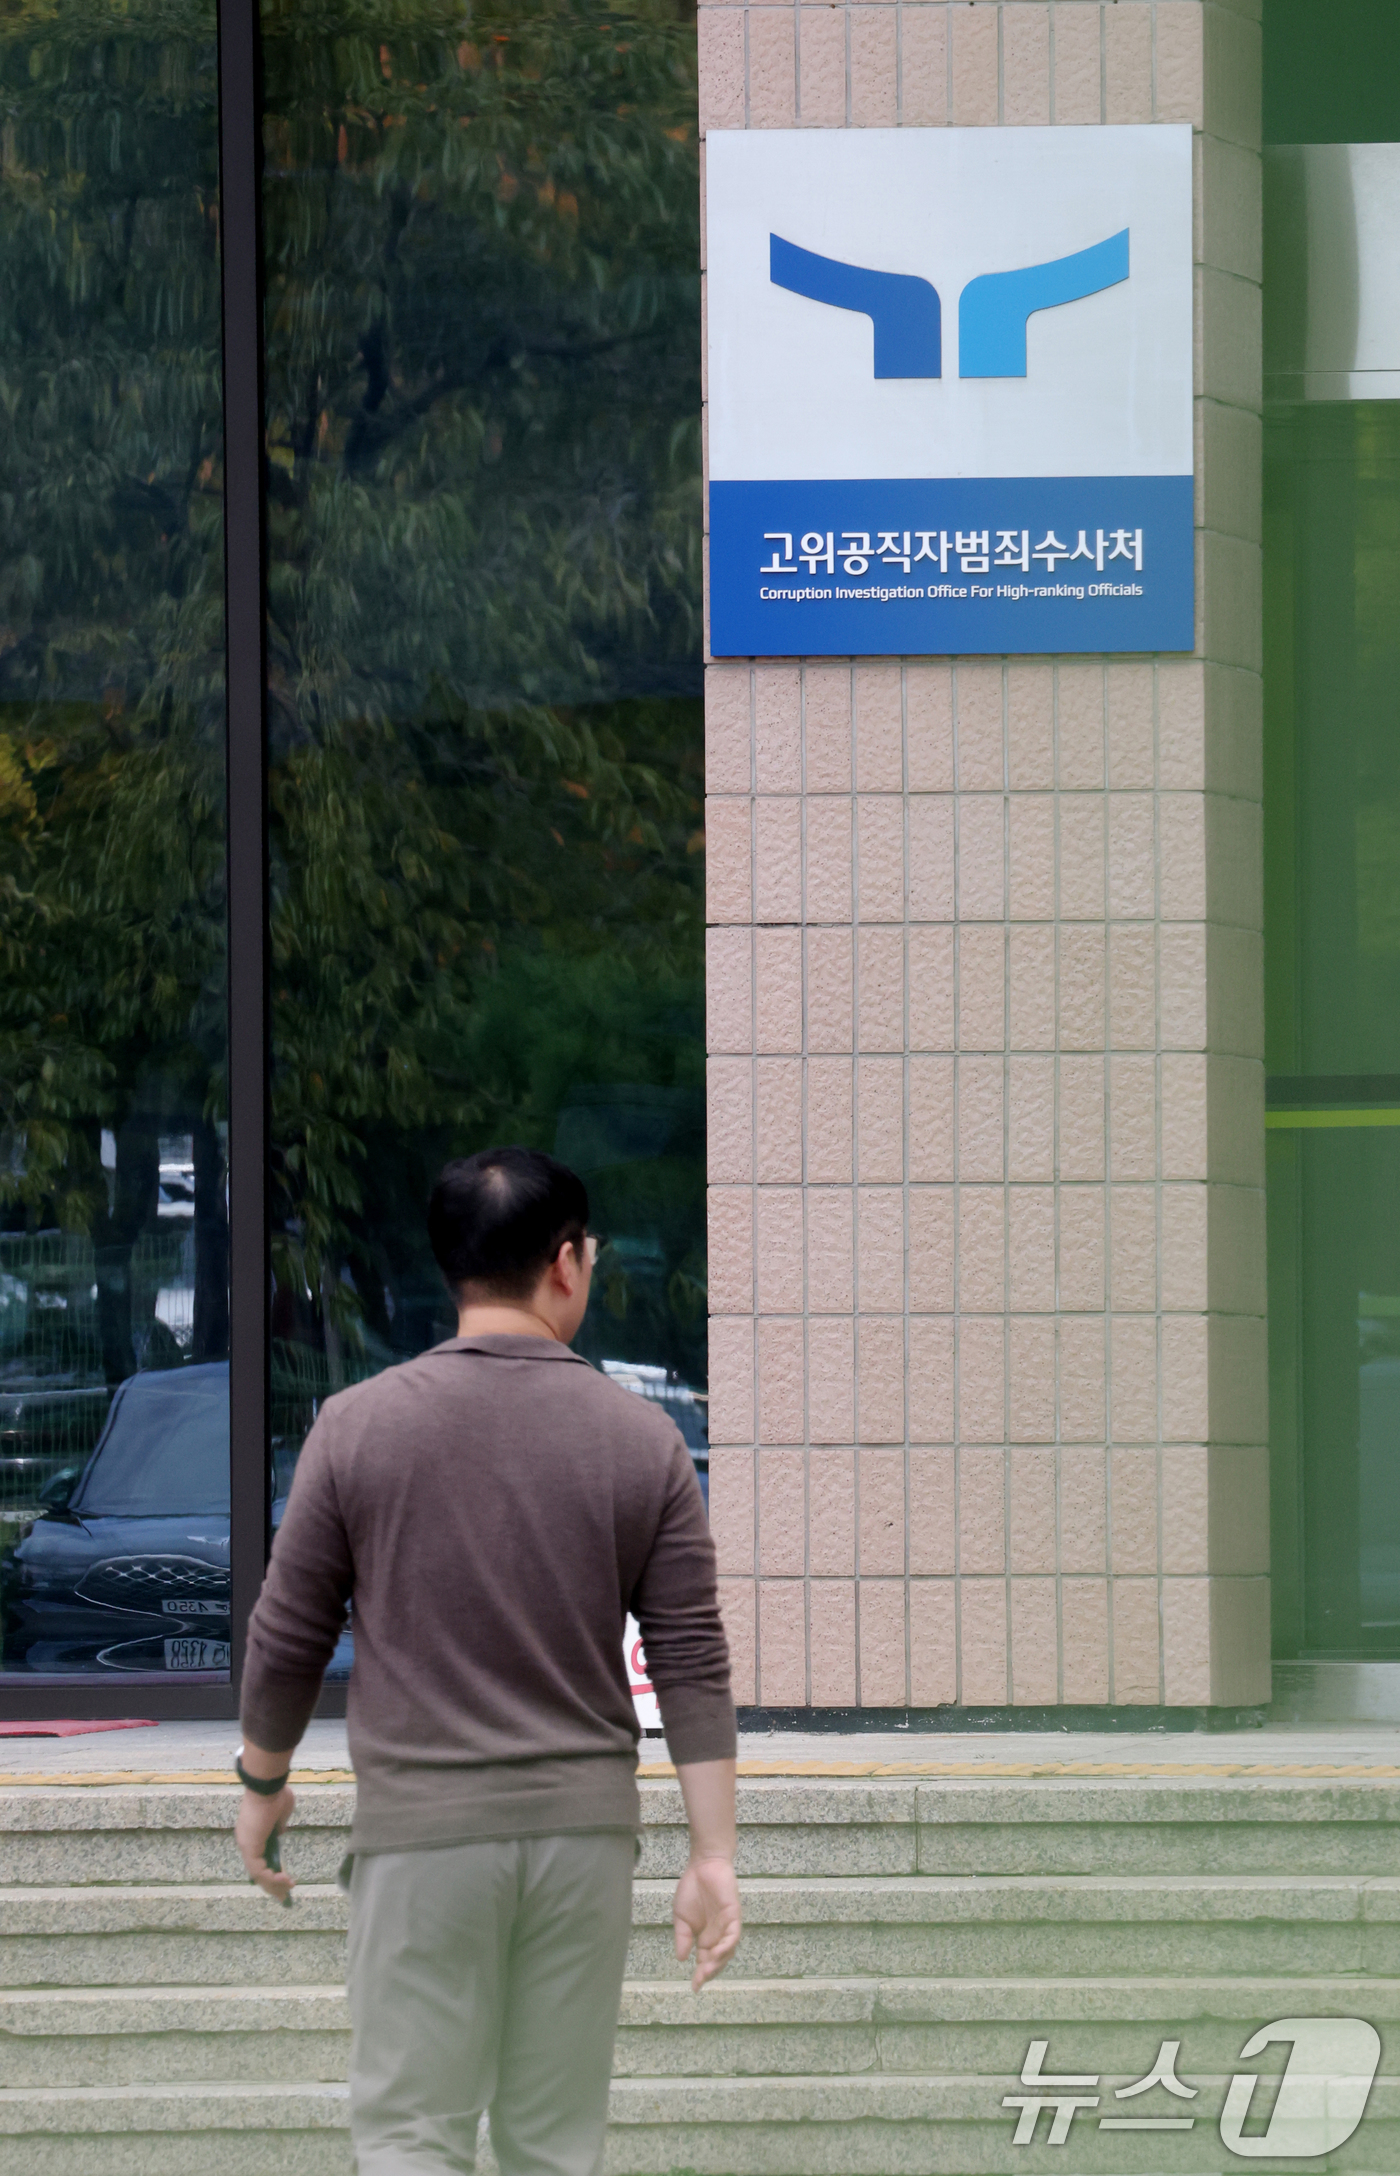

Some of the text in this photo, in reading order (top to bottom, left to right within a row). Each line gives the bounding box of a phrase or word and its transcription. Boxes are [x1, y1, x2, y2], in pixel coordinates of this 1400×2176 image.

[759, 528, 1143, 576] 고위공직자범죄수사처
[759, 582, 1144, 603] Corruption Investigation Office For High-ranking Officials
